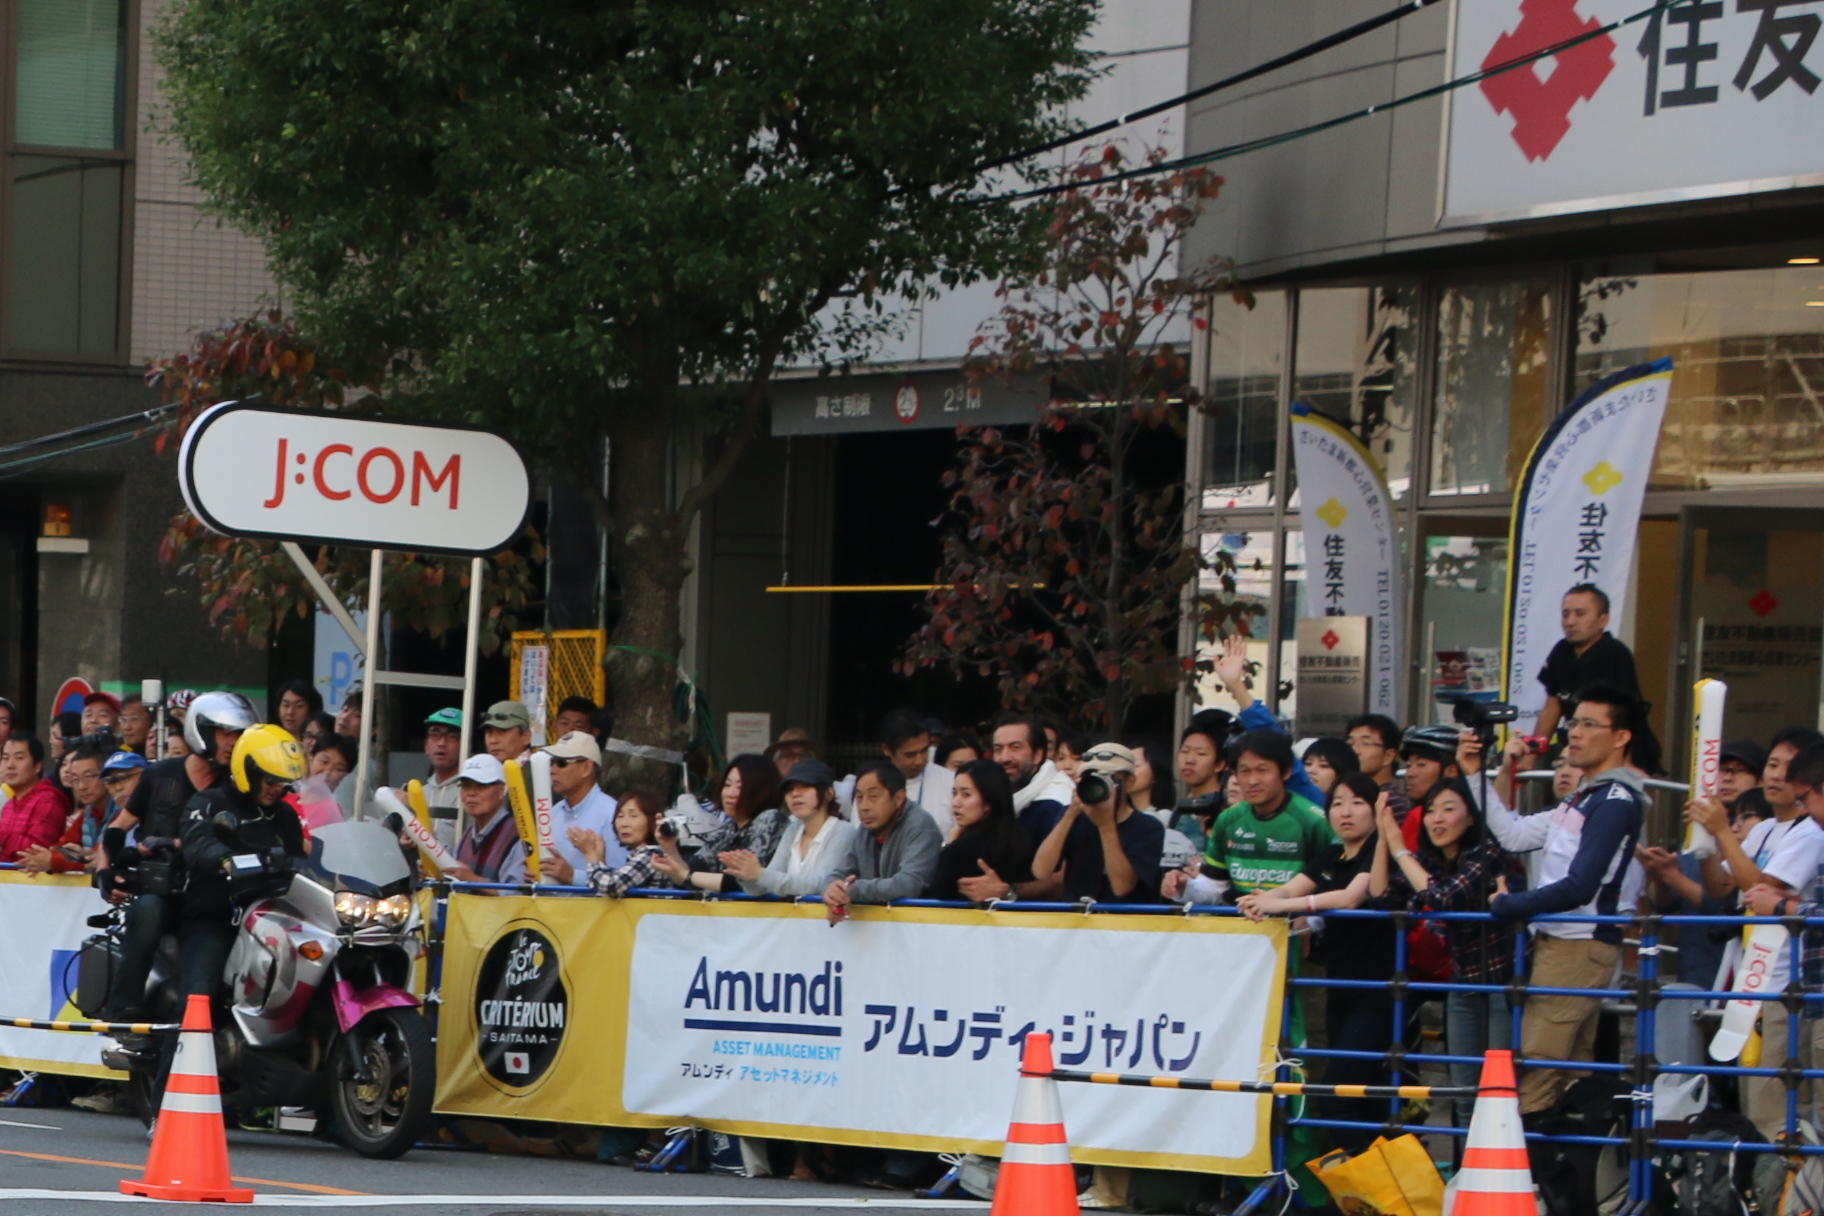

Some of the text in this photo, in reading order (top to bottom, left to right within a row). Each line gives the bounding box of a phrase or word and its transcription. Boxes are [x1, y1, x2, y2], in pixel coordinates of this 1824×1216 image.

[1636, 0, 1824, 117] 住友
[263, 438, 461, 510] J:COM
[536, 798, 555, 847] J:COM
[1230, 862, 1292, 882] Europcar
[684, 956, 843, 1016] Amundi
[480, 995, 563, 1028] CRITÉRIUM
[713, 1040, 841, 1061] ASSET MANAGEMENT
[681, 1063, 840, 1087] アムンディ アセットマネジメント
